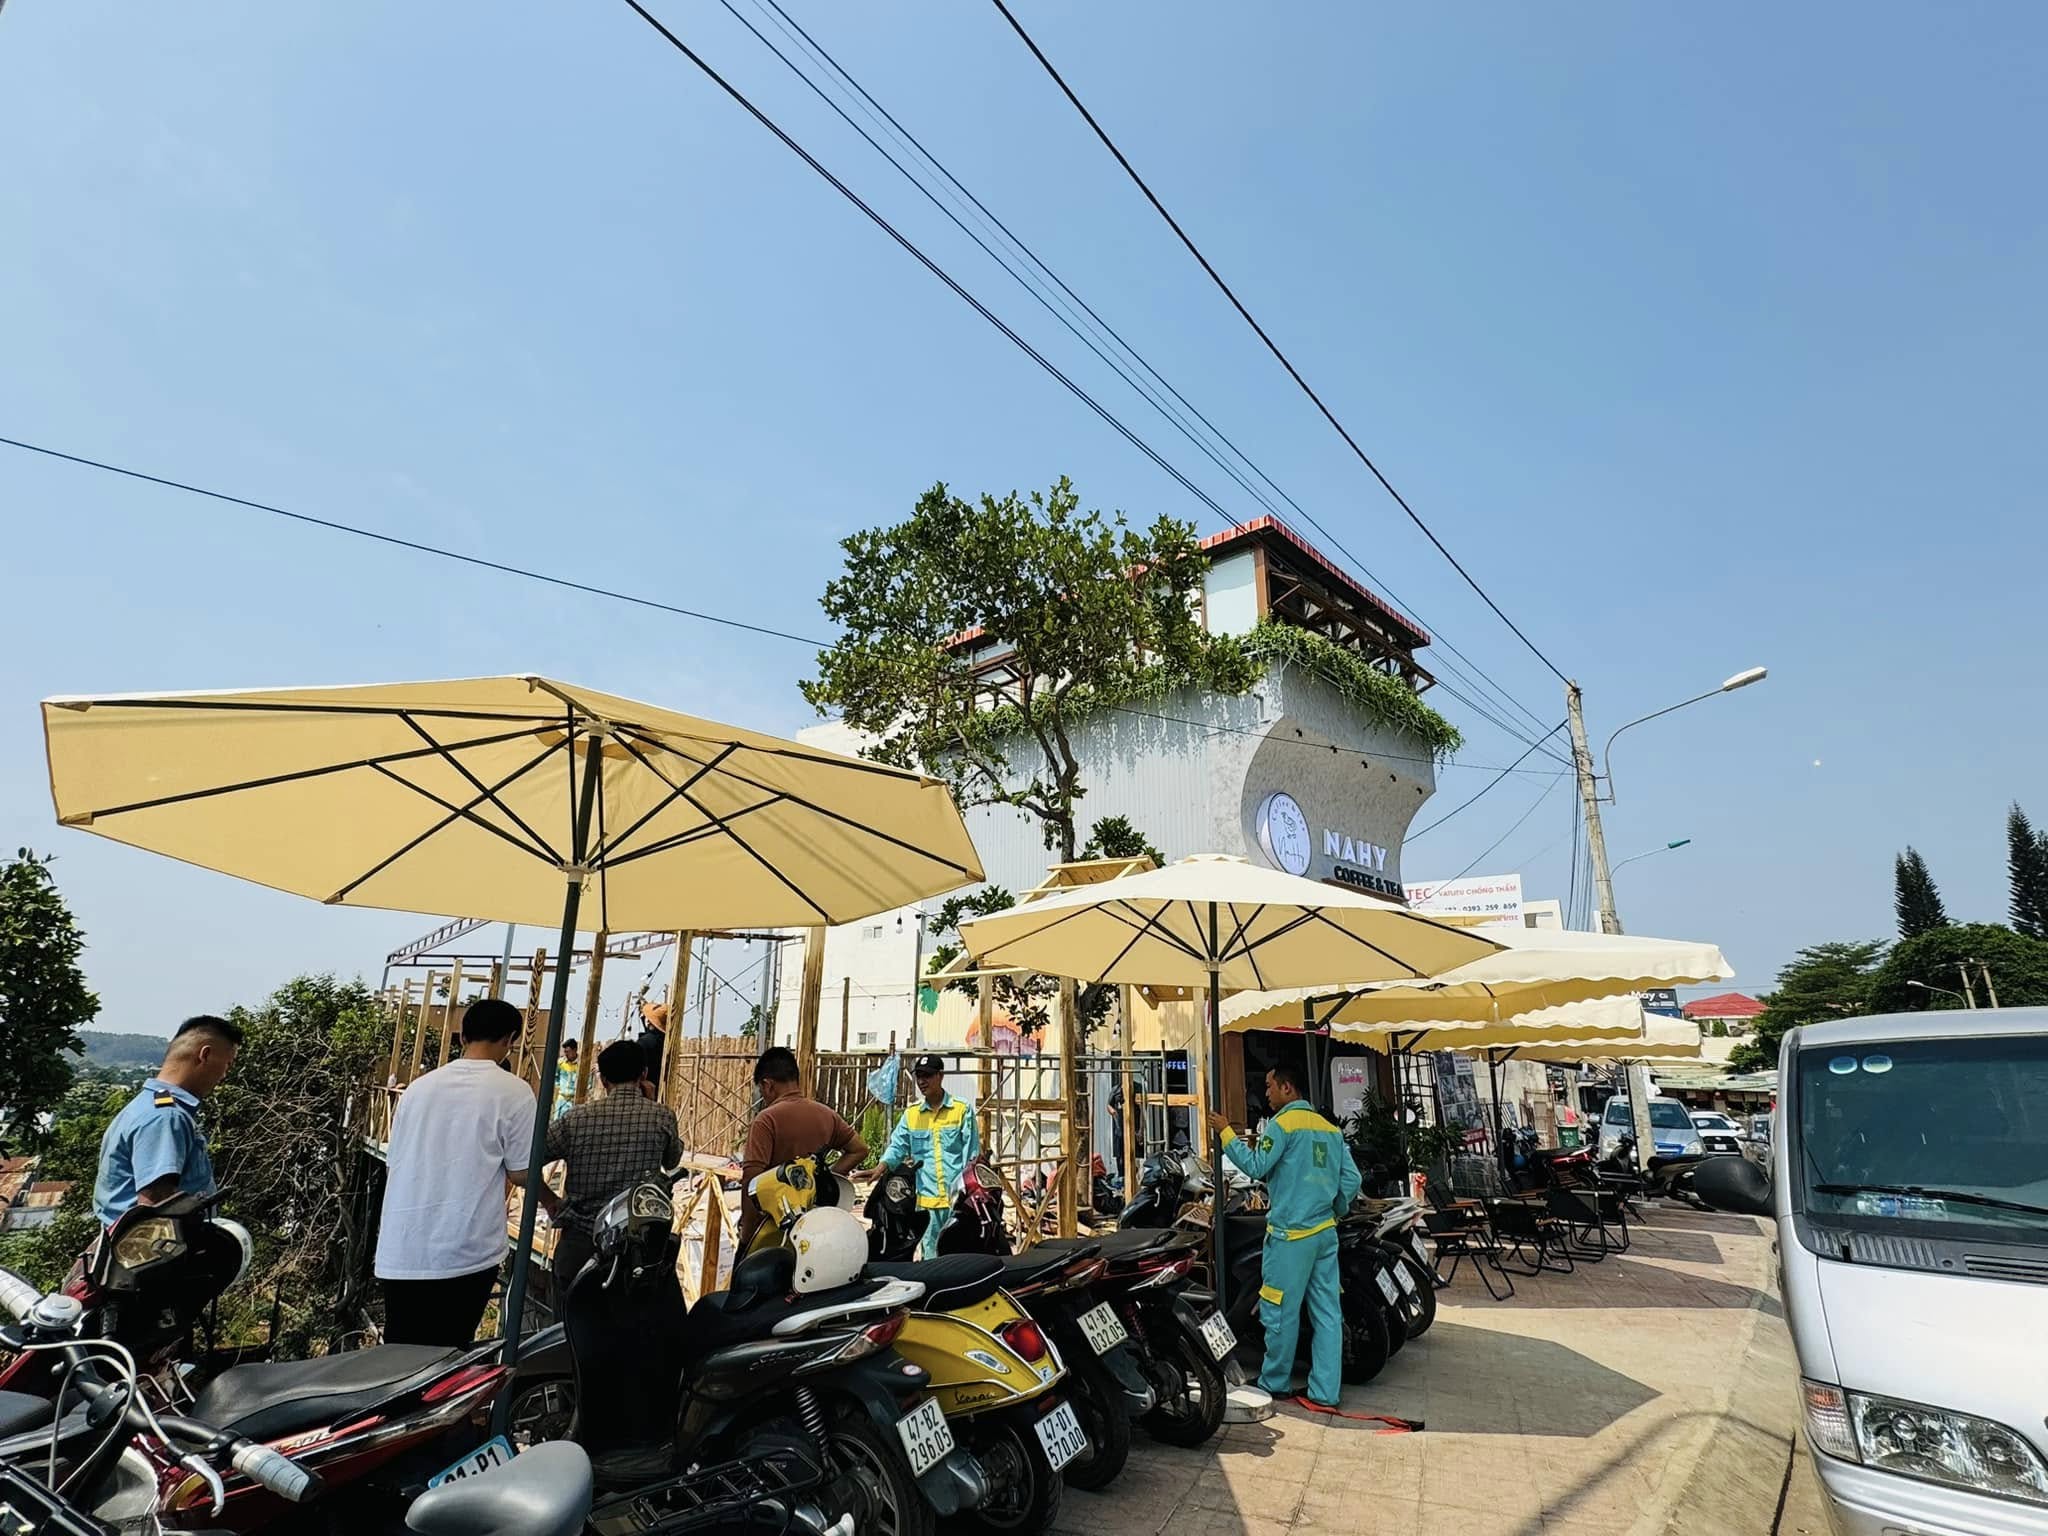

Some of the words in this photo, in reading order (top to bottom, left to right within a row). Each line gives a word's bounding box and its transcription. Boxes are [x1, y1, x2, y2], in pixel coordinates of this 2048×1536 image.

[1323, 828, 1386, 872] NAHY
[1334, 865, 1376, 890] COFFEE
[1375, 877, 1384, 892] &
[1383, 879, 1405, 898] TEA
[1090, 1321, 1125, 1351] 032.05
[911, 1425, 951, 1472] 296.05
[1047, 1427, 1085, 1467] 570.00
